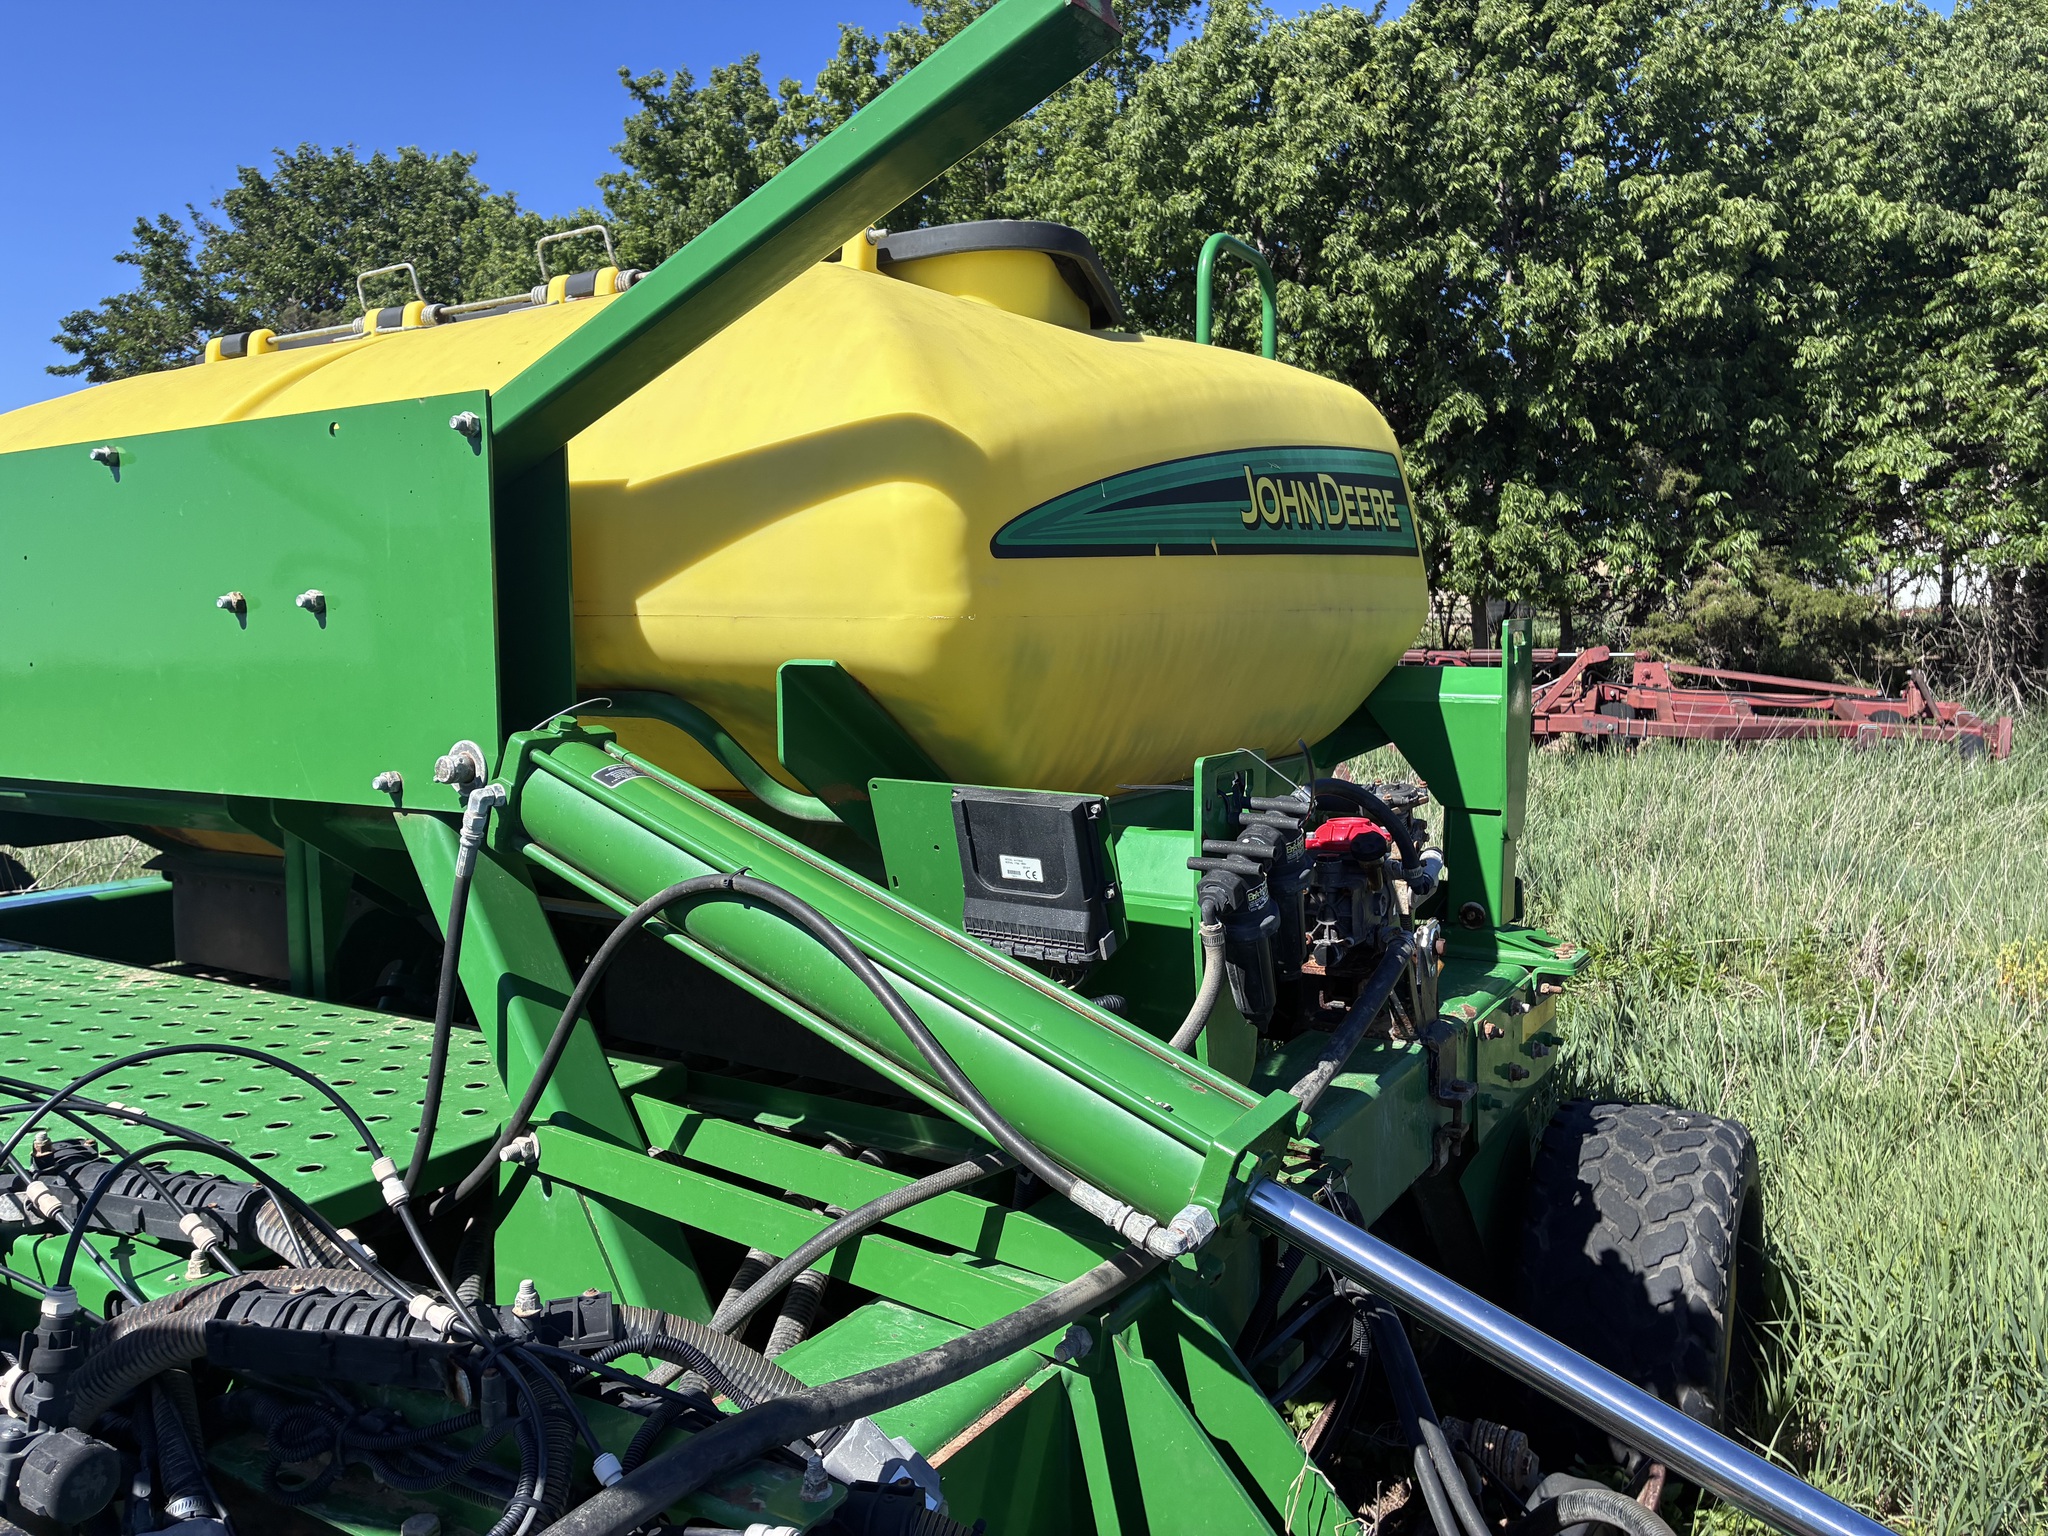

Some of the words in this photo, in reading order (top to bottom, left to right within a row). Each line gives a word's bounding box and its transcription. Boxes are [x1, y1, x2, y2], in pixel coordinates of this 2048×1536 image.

[1240, 465, 1324, 527] JOHN
[1317, 473, 1402, 529] DEERE
[1025, 869, 1038, 880] CE
